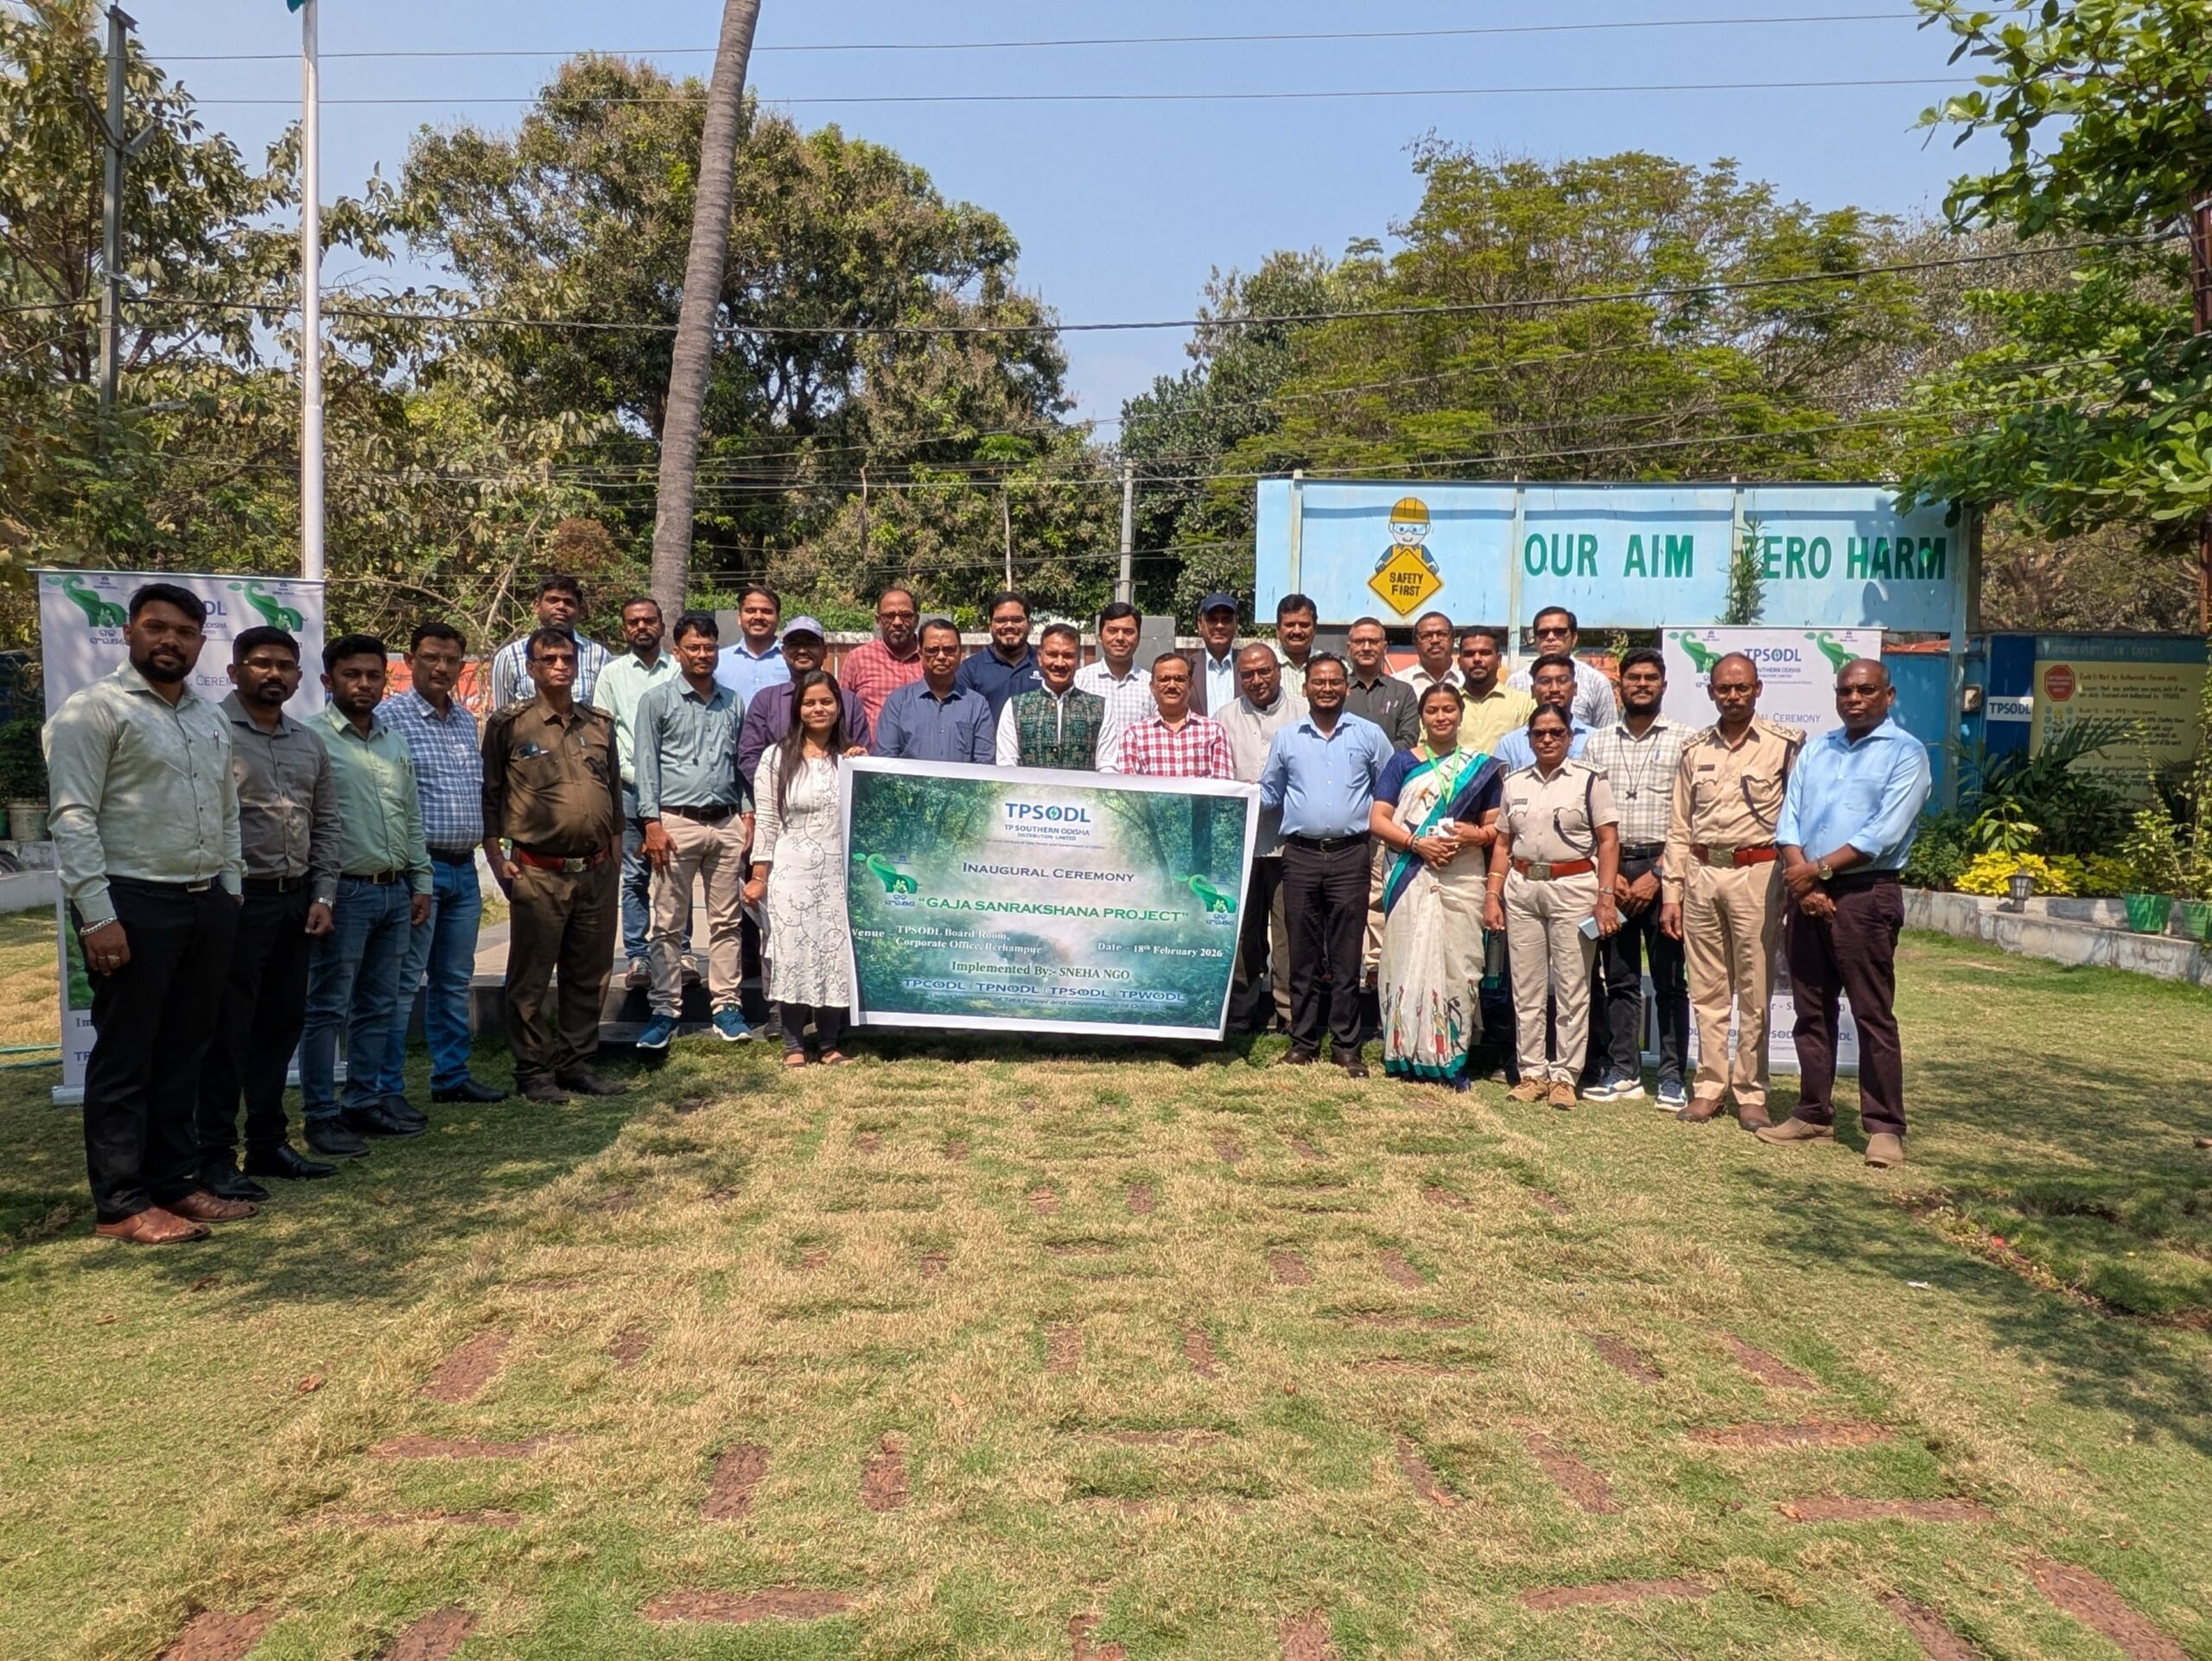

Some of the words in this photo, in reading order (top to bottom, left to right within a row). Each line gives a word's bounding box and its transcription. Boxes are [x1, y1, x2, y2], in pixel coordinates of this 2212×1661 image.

[1524, 532, 1599, 577] OUR
[1623, 534, 1694, 578] AIM
[1847, 537, 1946, 580] HARM
[1389, 572, 1423, 584] SAFETY
[1391, 585, 1421, 596] FIRST
[1989, 703, 2031, 715] TPSODL
[1773, 712, 1821, 723] CEREMONY
[1005, 802, 1090, 823] TPSODL
[1014, 824, 1059, 834] SOUTHERN
[1061, 828, 1090, 837] ODISHA
[963, 862, 1049, 877] INAUGURAL
[1052, 868, 1135, 882] CEREMONY
[975, 901, 1099, 918] SANRAKSHANA
[852, 928, 885, 938] Venue
[896, 926, 942, 936] TPSODL
[944, 928, 975, 939] Board
[895, 937, 946, 949] Corporate
[985, 942, 1042, 954] Berhampur
[1097, 942, 1122, 951] Date
[1154, 945, 1198, 958] February
[1200, 948, 1223, 958] 2026
[951, 960, 1030, 975] Implemented
[1058, 967, 1100, 979] SNEHA
[1103, 970, 1130, 980] NGO
[904, 979, 966, 990] TPCODL
[976, 983, 1039, 994] TPNODL
[1049, 987, 1109, 997] TPSODL
[1120, 990, 1185, 1002] TPWODL
